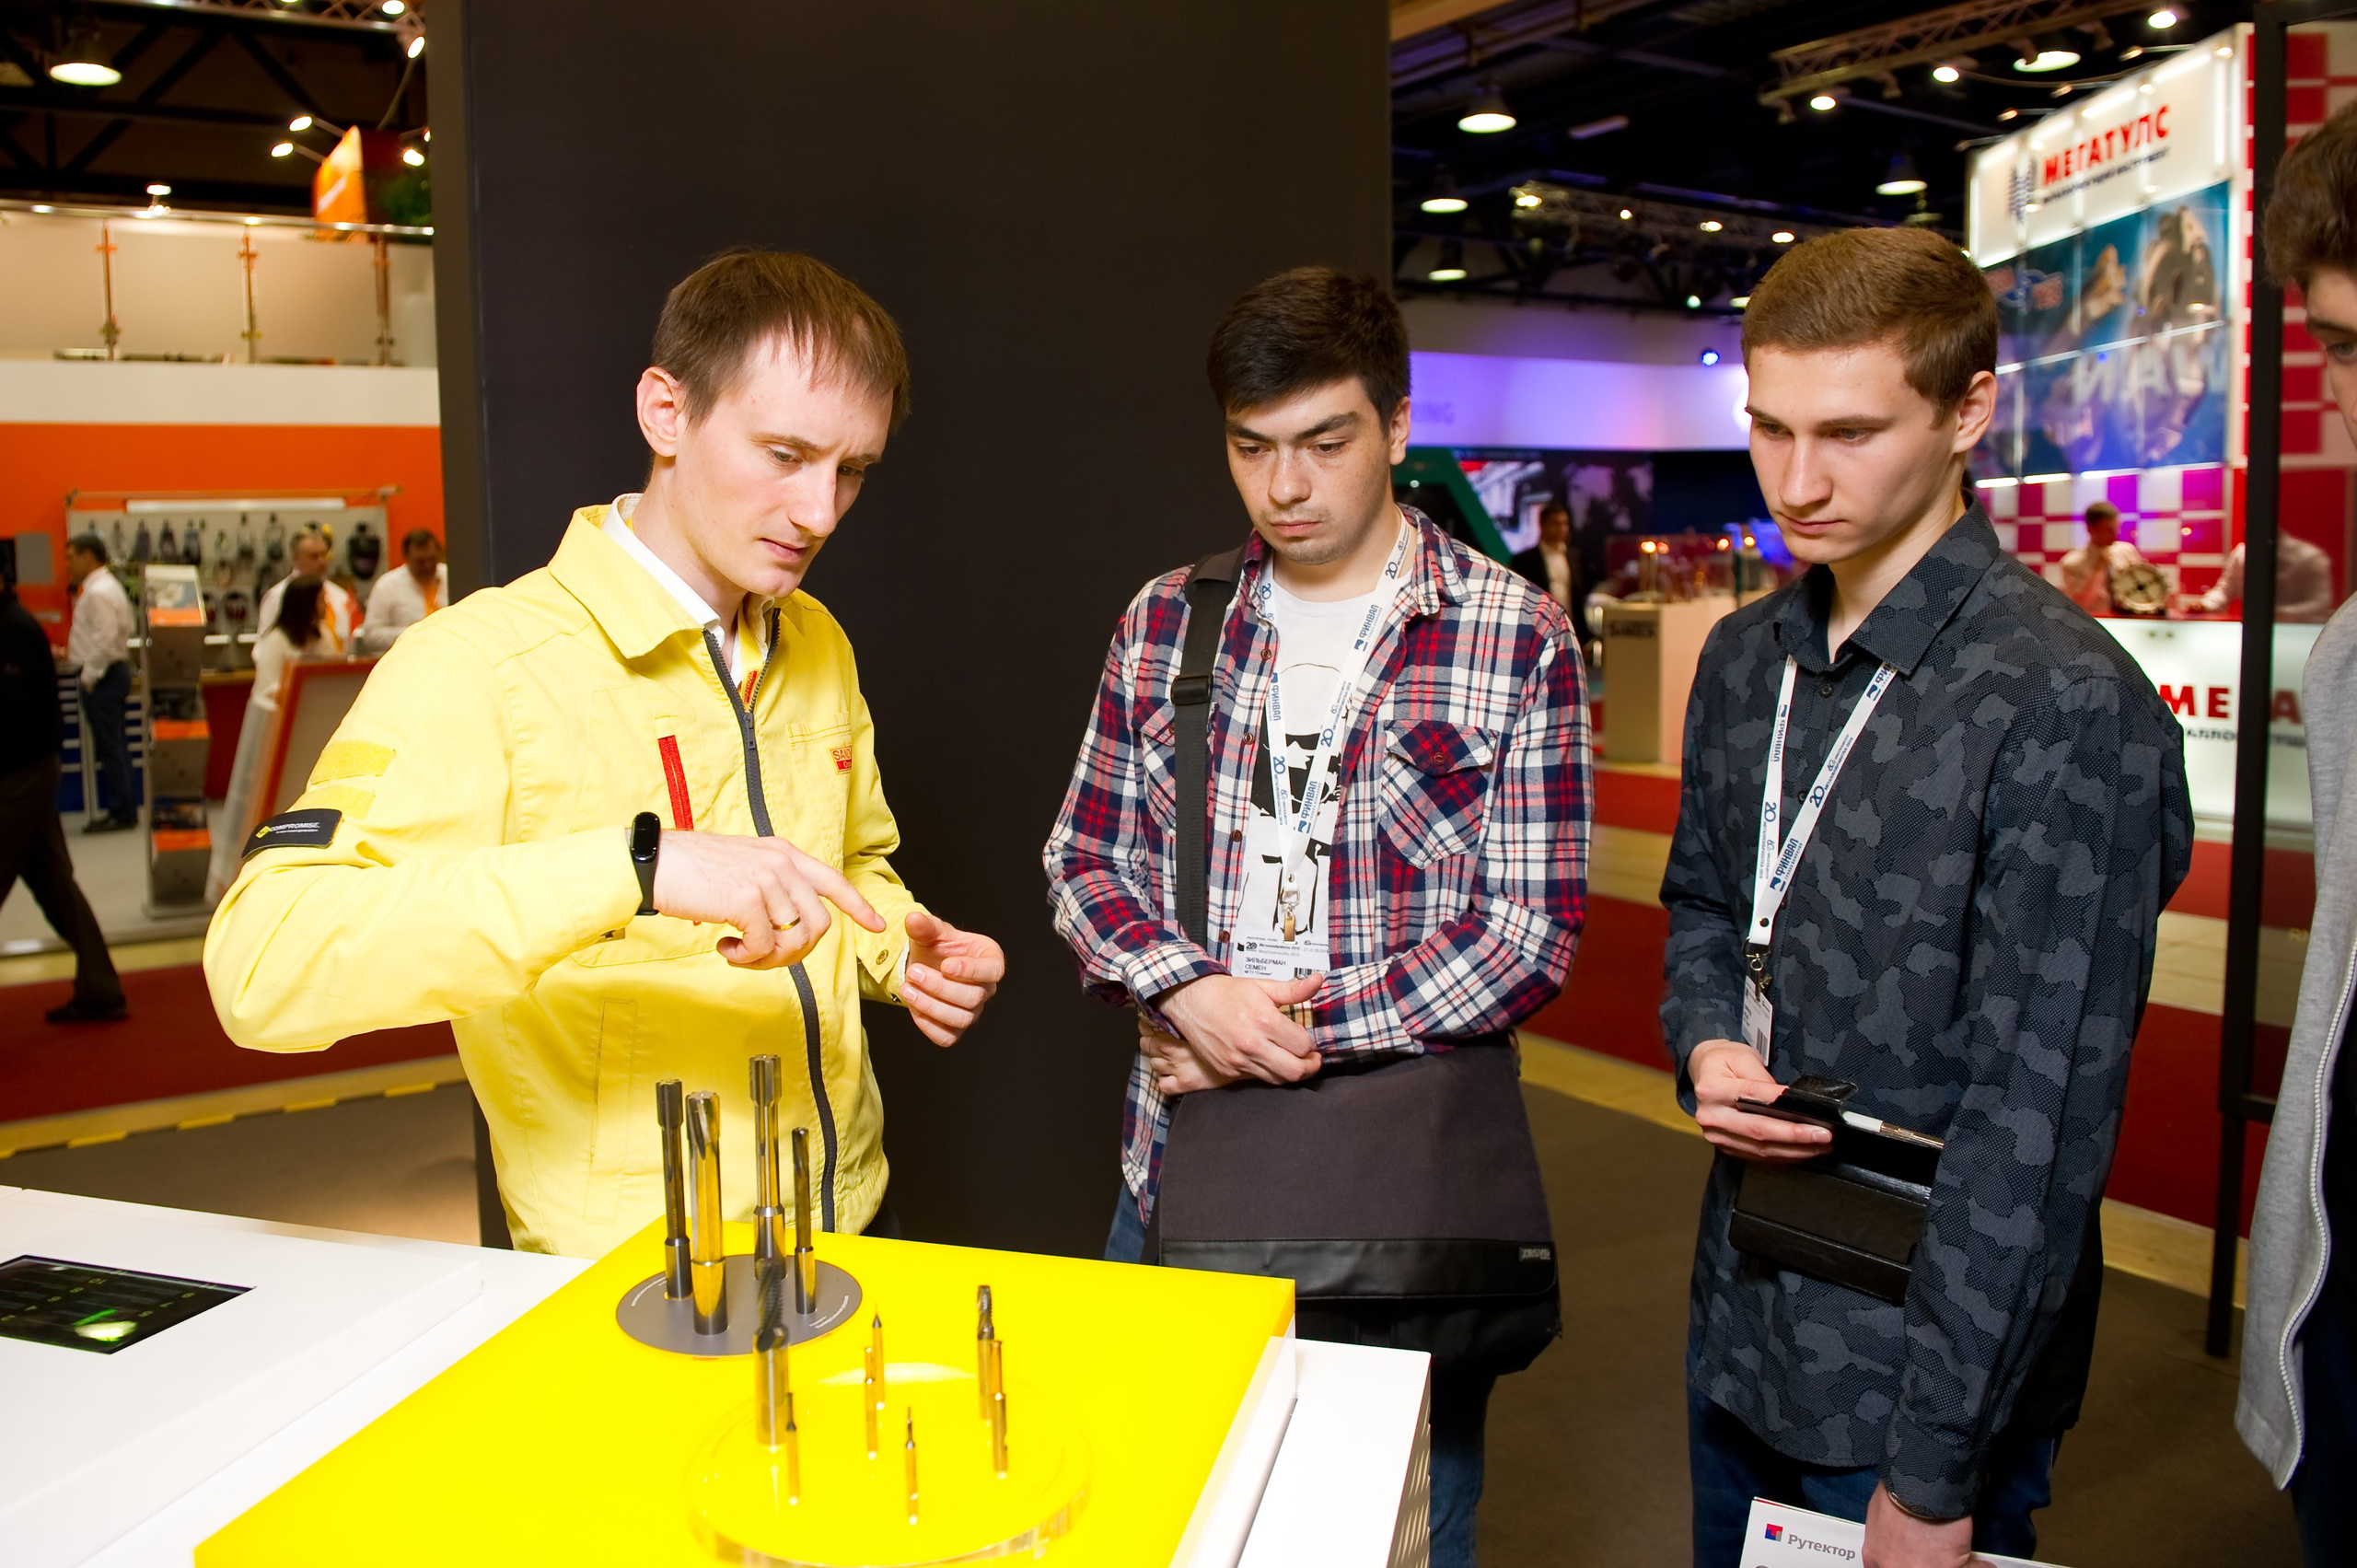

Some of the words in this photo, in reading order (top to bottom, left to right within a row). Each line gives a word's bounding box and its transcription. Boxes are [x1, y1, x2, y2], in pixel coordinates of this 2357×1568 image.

[2043, 105, 2169, 186] МЕГАТУЛС
[1385, 562, 1399, 579] 20
[1261, 583, 1271, 599] 20
[1359, 604, 1379, 638] ФИНВАЛ
[1271, 685, 1282, 721] ФИНВАЛ
[2159, 684, 2303, 726] МЕА
[1320, 728, 1334, 748] 20
[1273, 756, 1286, 775] 20
[1301, 781, 1318, 819] ФИНВАЛ
[1809, 785, 1825, 808] 20
[1764, 801, 1777, 822] 20
[1775, 838, 1799, 877] ФИНВАЛ
[1245, 958, 1286, 966] ЗИЛЬБЕРМАН
[1788, 1534, 1856, 1561] Рутектор
